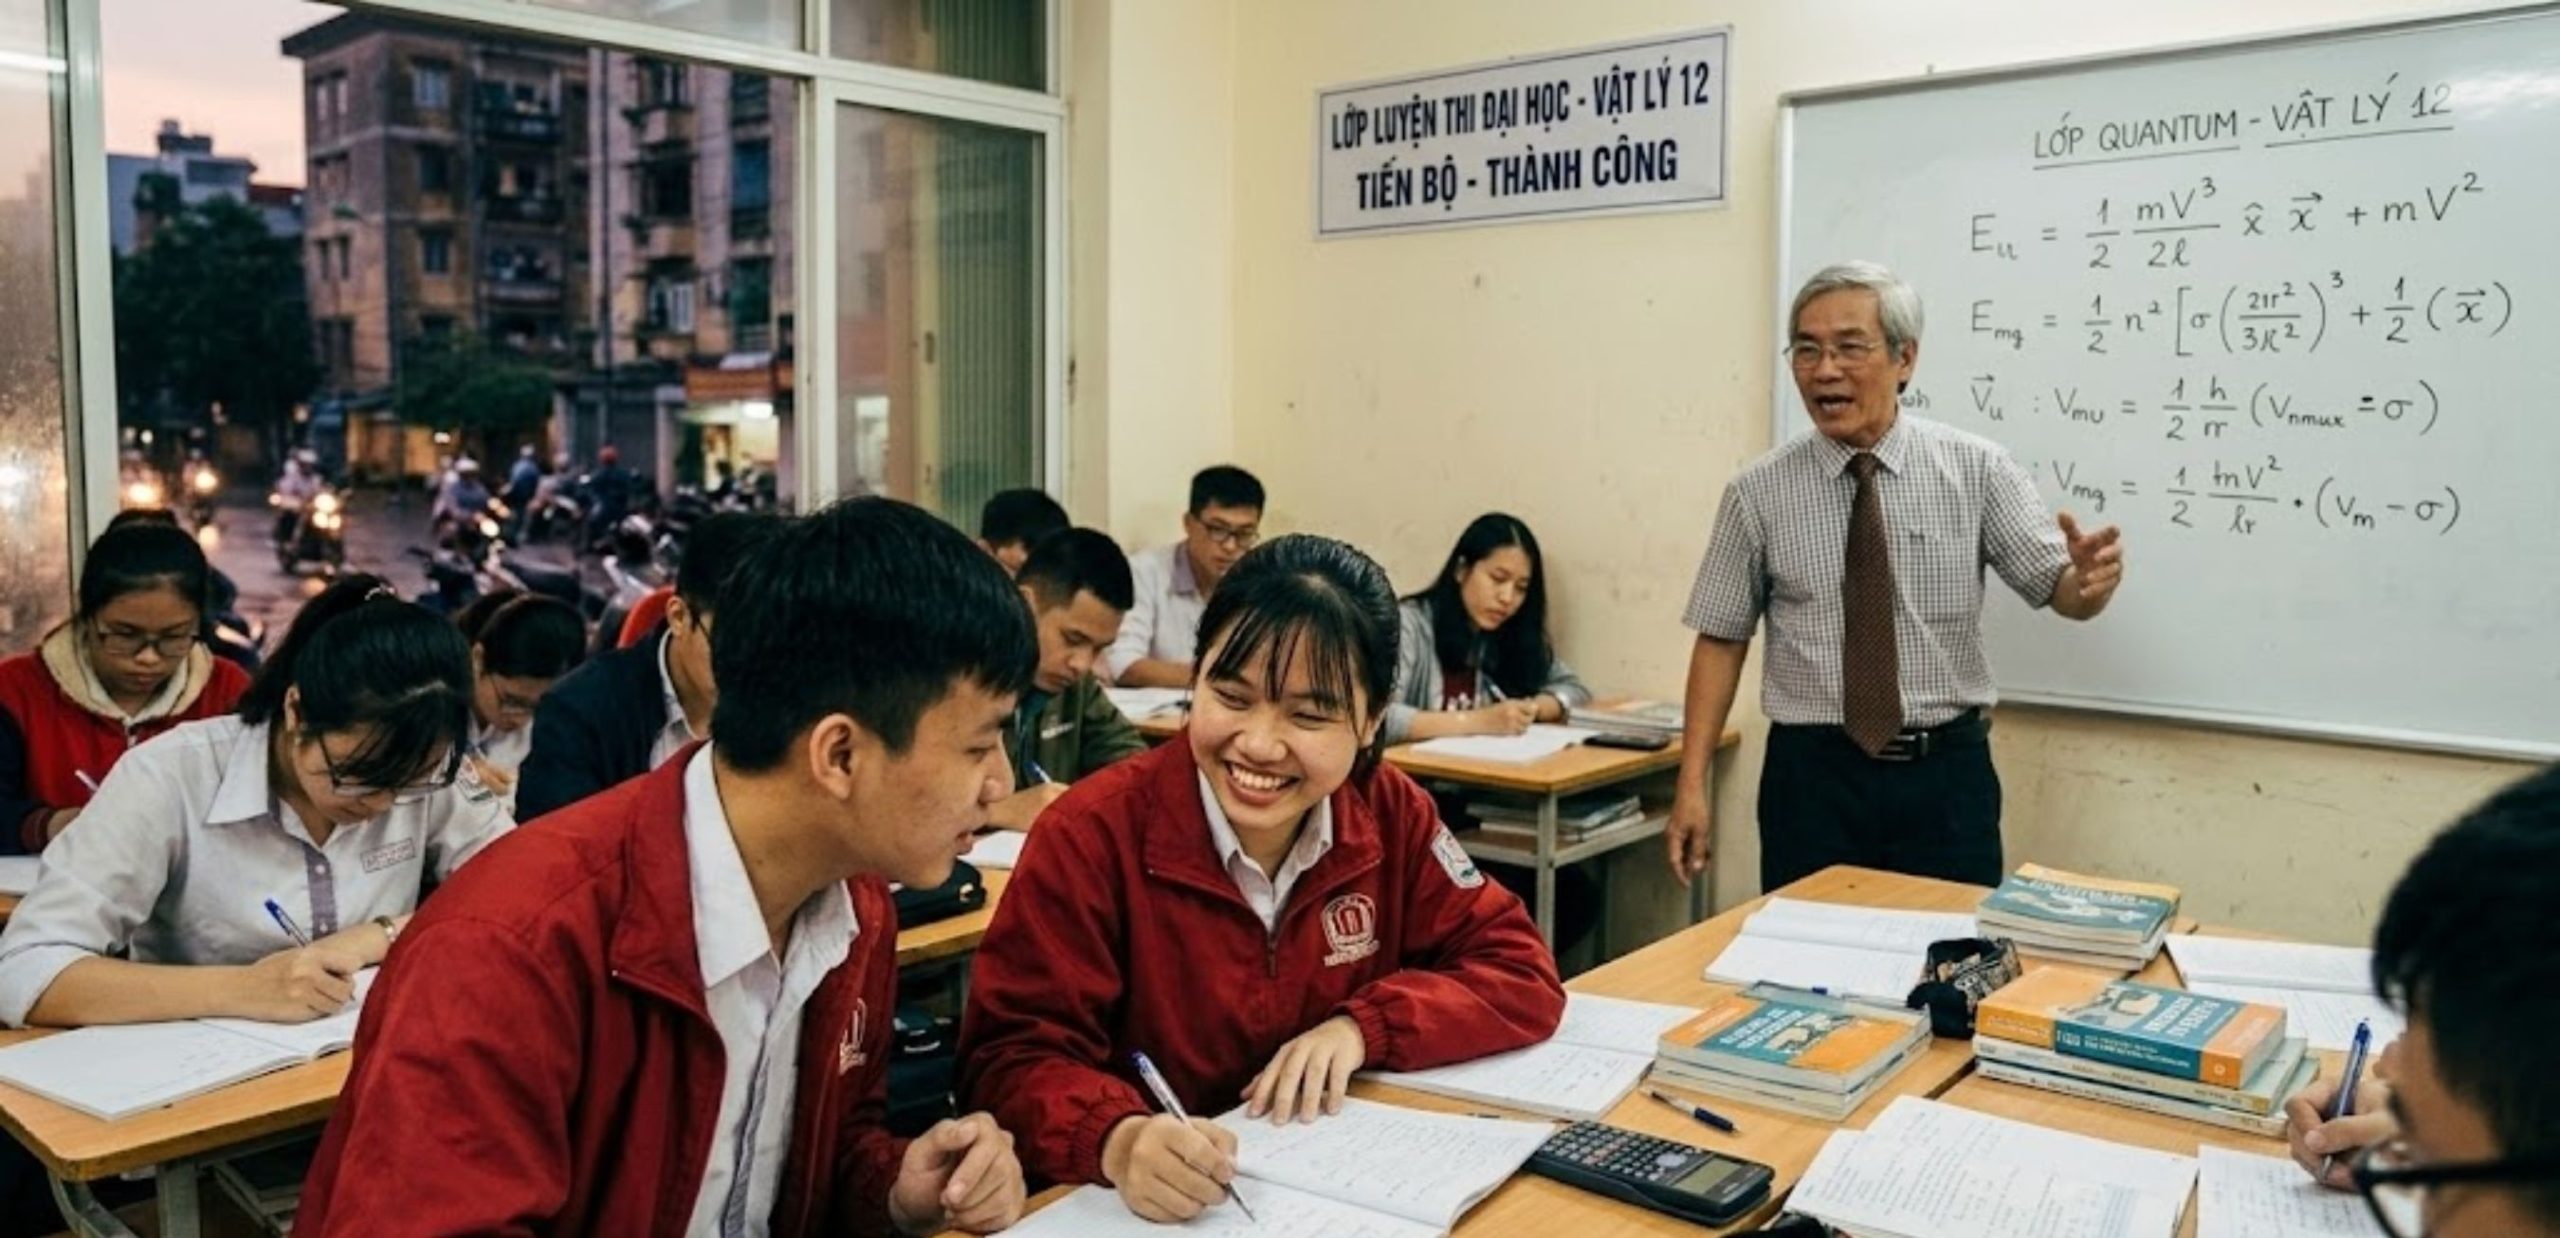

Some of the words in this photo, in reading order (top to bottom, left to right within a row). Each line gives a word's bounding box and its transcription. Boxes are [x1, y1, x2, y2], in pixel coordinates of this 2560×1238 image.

[1332, 102, 1368, 150] LỚP
[1374, 93, 1436, 149] LUYỆN
[1443, 93, 1476, 136] THI
[1482, 86, 1519, 138] ĐẠI
[1525, 80, 1570, 133] HỌC
[1593, 64, 1637, 125] VẬT
[1644, 56, 1671, 111] LÝ
[1680, 61, 1710, 107] 12
[2034, 111, 2084, 159] LỚP
[2099, 109, 2238, 152] QUANTUM
[2271, 88, 2335, 139] VẬT
[2351, 72, 2399, 125] LÝ
[2410, 82, 2453, 119] 12
[1357, 154, 1413, 210] TIẾN
[1422, 153, 1457, 212] BỘ
[1487, 144, 1582, 198] THÀNH
[1592, 134, 1678, 188] CÔNG
